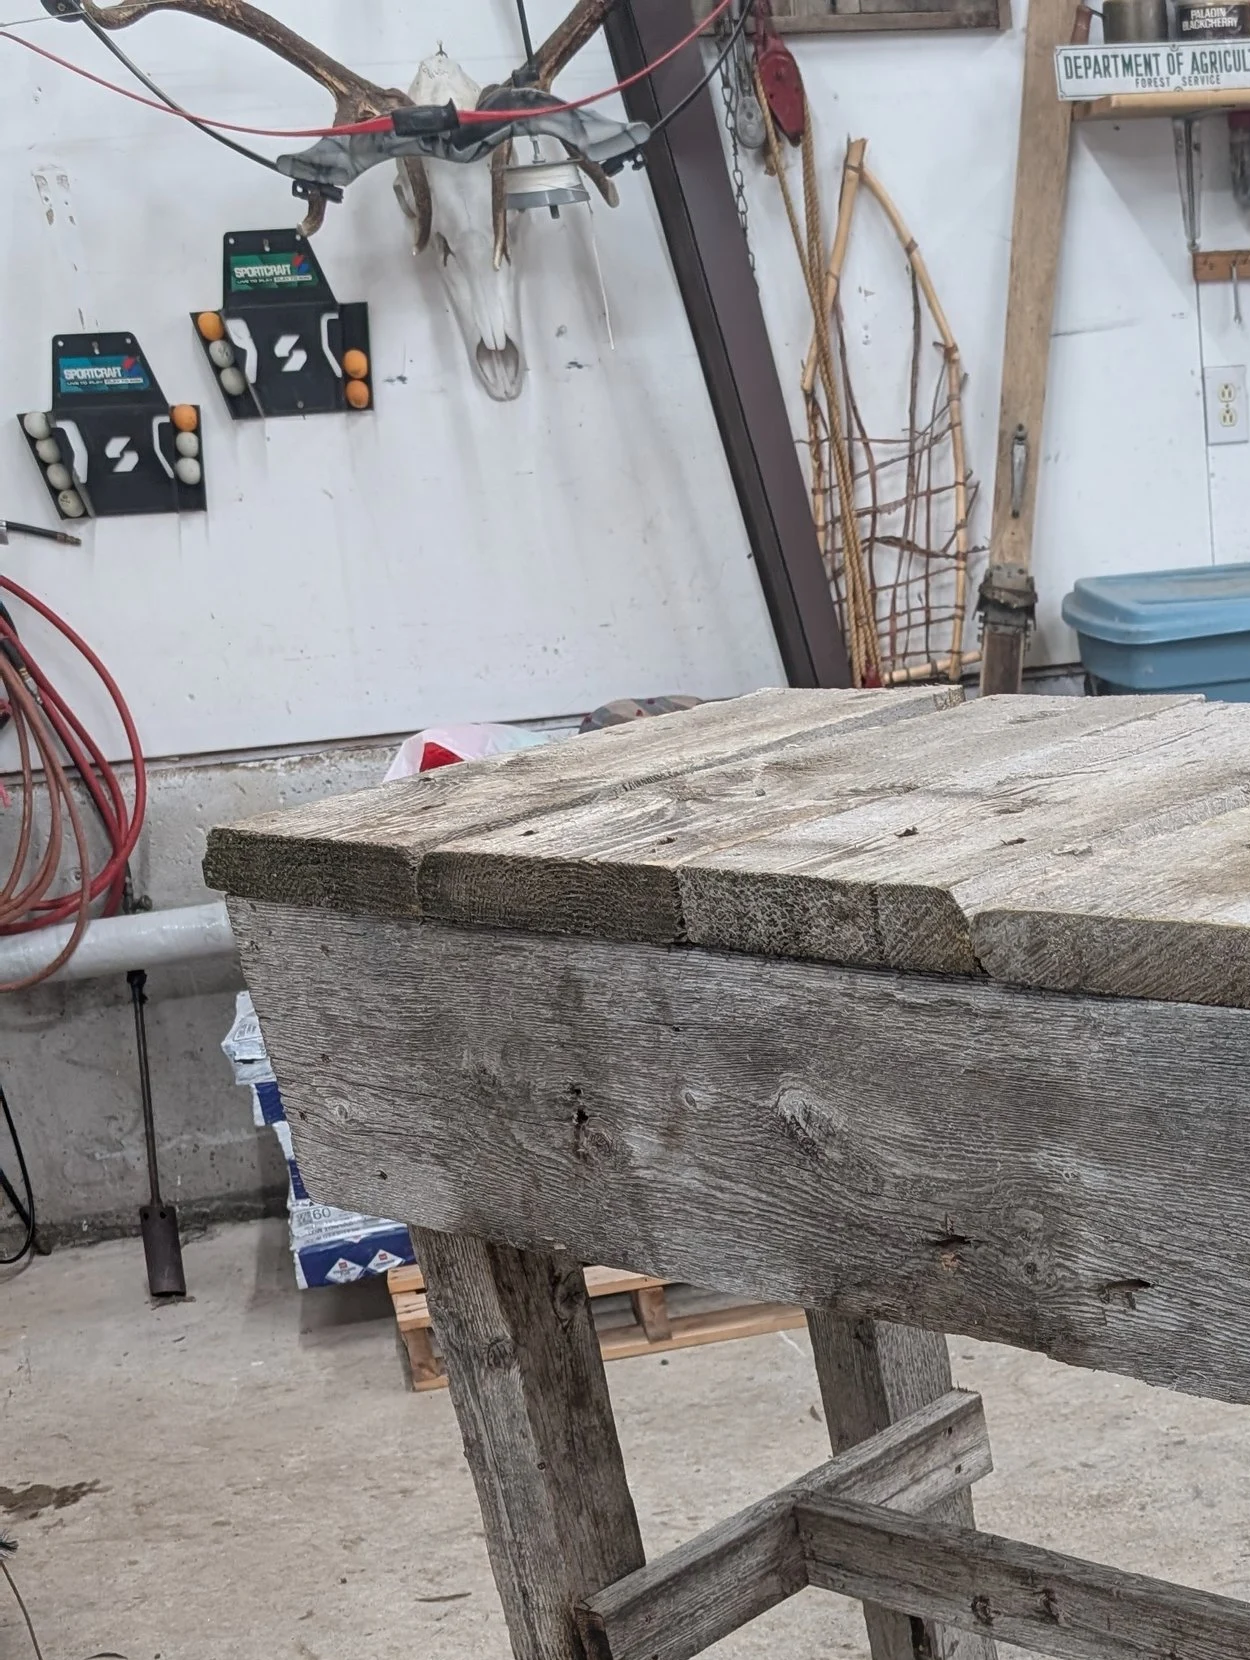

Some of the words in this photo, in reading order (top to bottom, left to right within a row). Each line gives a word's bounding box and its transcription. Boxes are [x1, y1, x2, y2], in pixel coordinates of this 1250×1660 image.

[1190, 7, 1227, 20] PALADIN
[1182, 16, 1239, 32] BLACKCHERRY
[1063, 52, 1162, 80] DEPARTMENT
[1166, 51, 1184, 76] OF
[1135, 76, 1171, 89] FOREST
[1181, 74, 1222, 88] SERVICE
[234, 264, 291, 278] SPORTCRAFT
[64, 367, 121, 380] SPORTCRAFT
